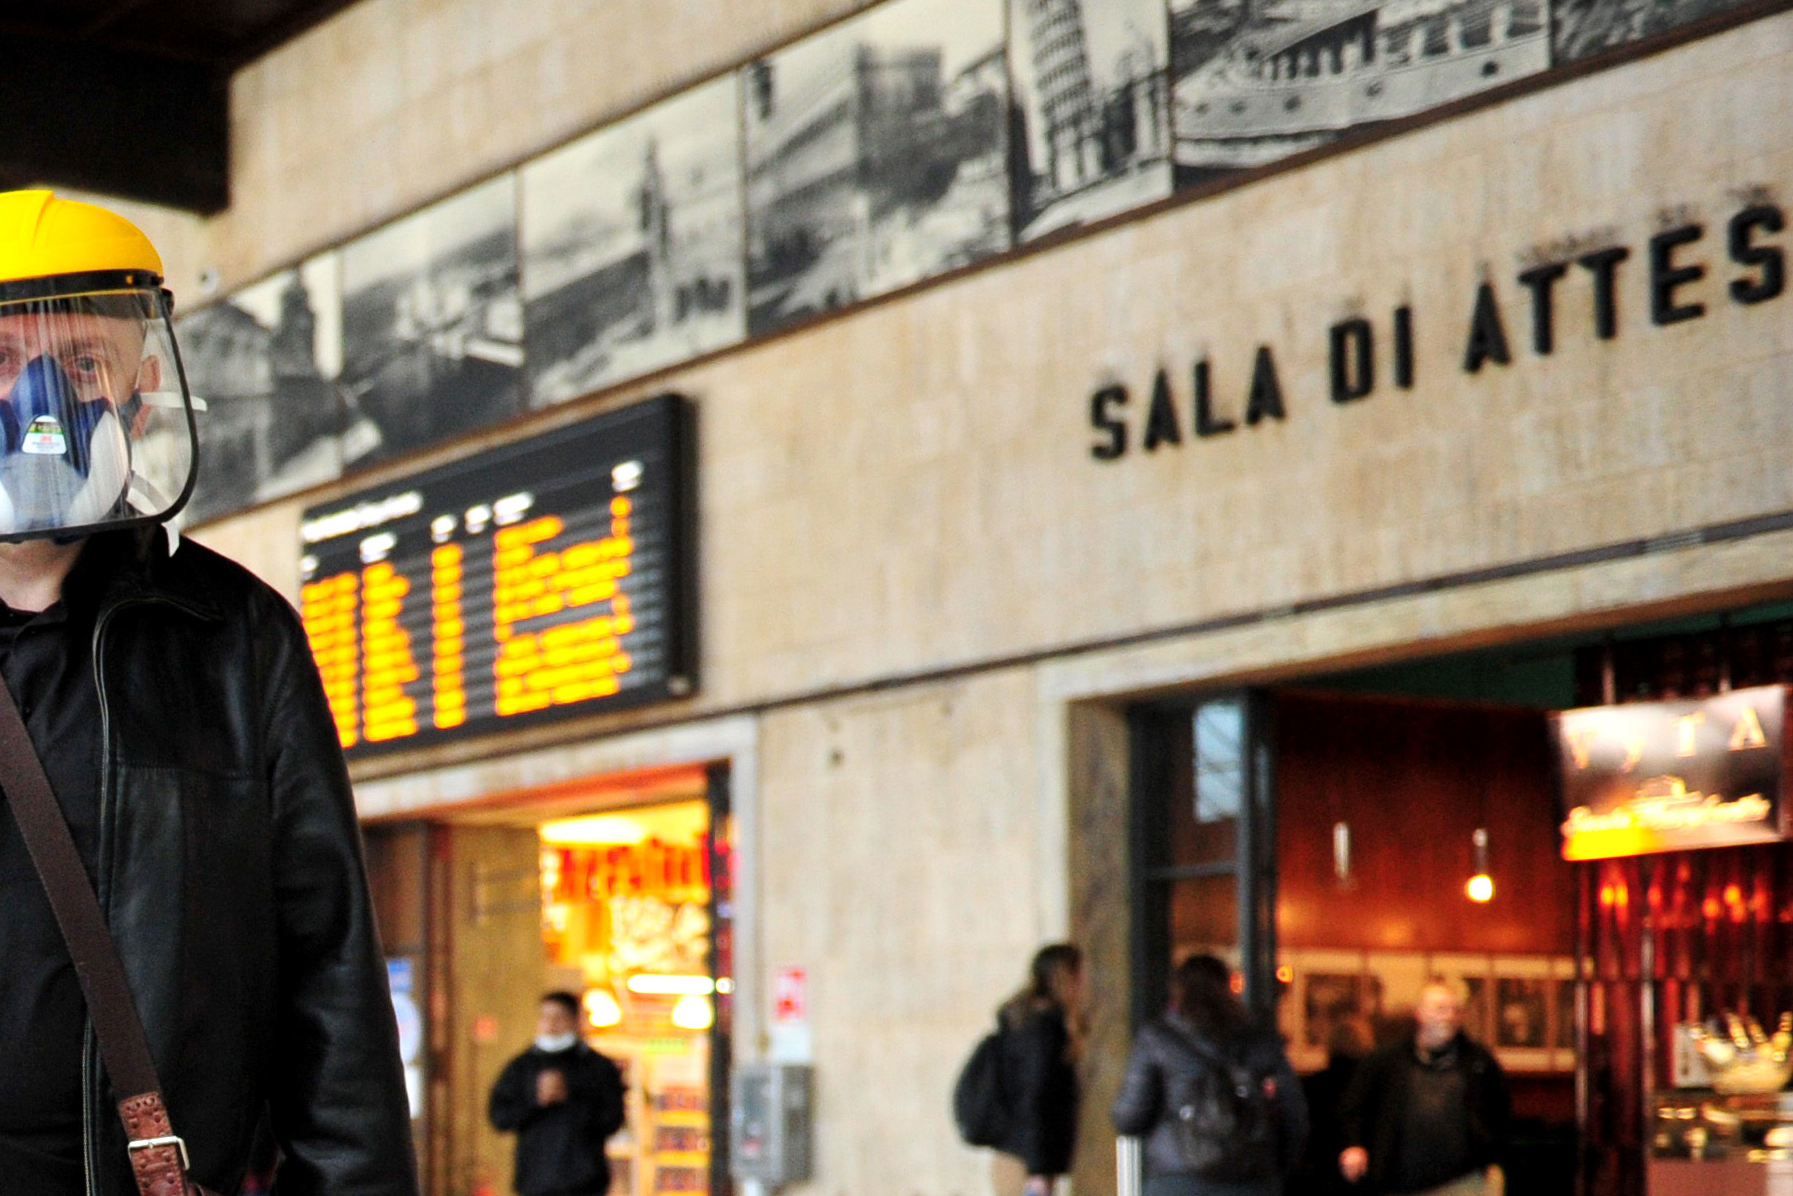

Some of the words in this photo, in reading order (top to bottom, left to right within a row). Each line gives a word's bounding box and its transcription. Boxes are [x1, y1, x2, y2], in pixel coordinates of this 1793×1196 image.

[1091, 346, 1286, 461] SALA
[1329, 304, 1415, 405] DI
[1463, 204, 1788, 375] ATTES
